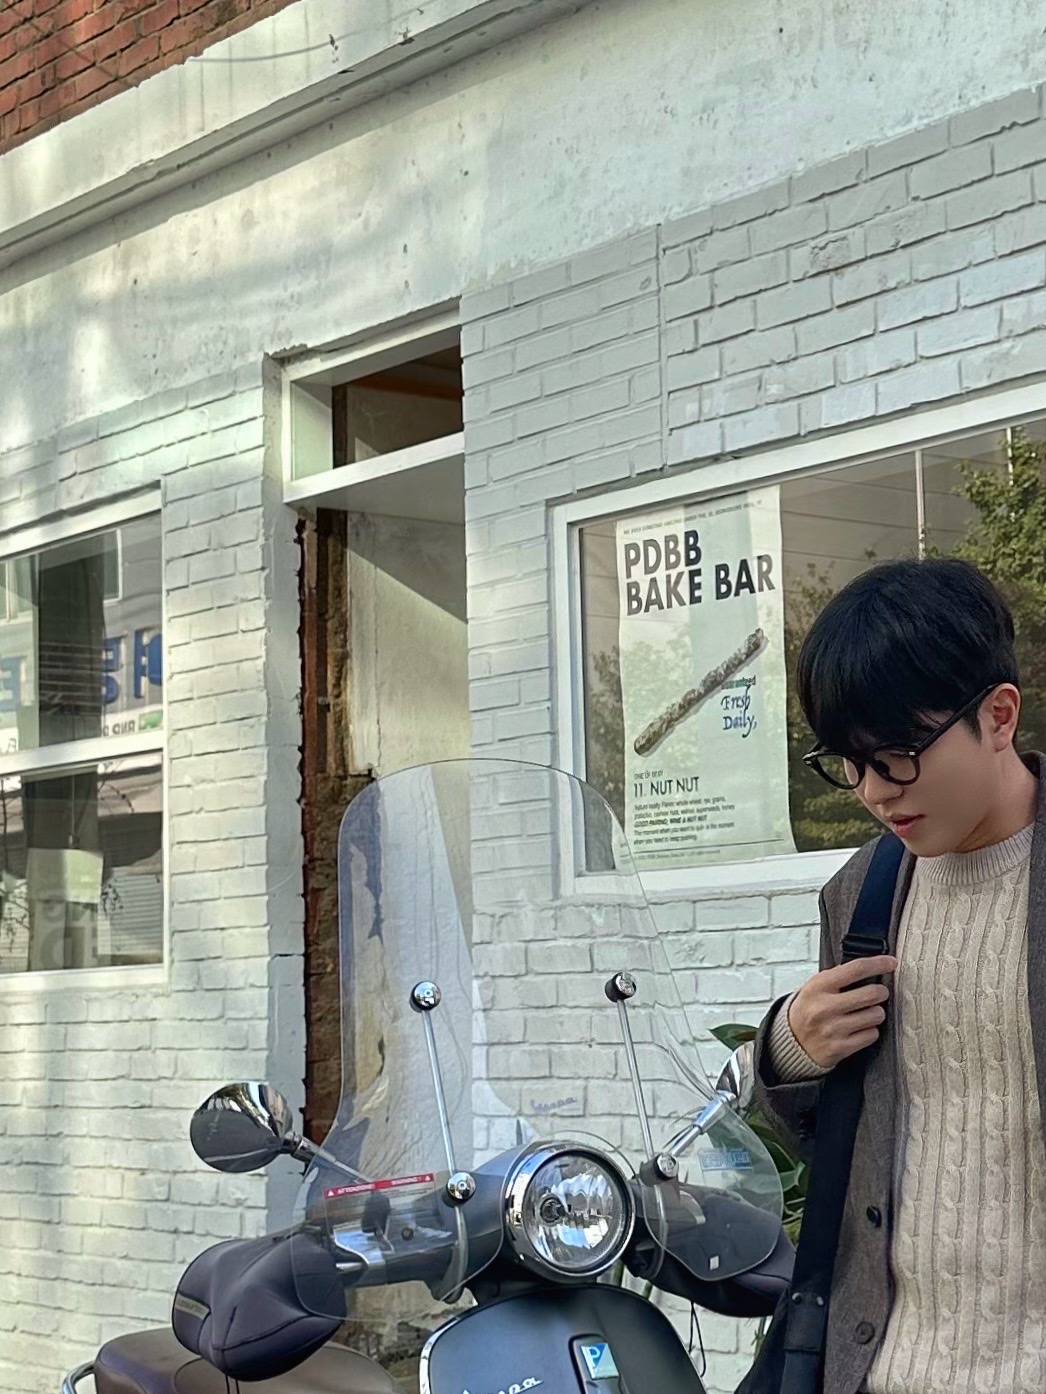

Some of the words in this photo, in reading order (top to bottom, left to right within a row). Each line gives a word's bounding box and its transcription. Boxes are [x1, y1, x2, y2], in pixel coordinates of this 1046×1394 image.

[624, 529, 702, 580] PDBB
[626, 568, 702, 617] BAKE
[715, 553, 776, 601] BAR
[650, 779, 673, 796] NUT
[676, 776, 700, 793] NUT
